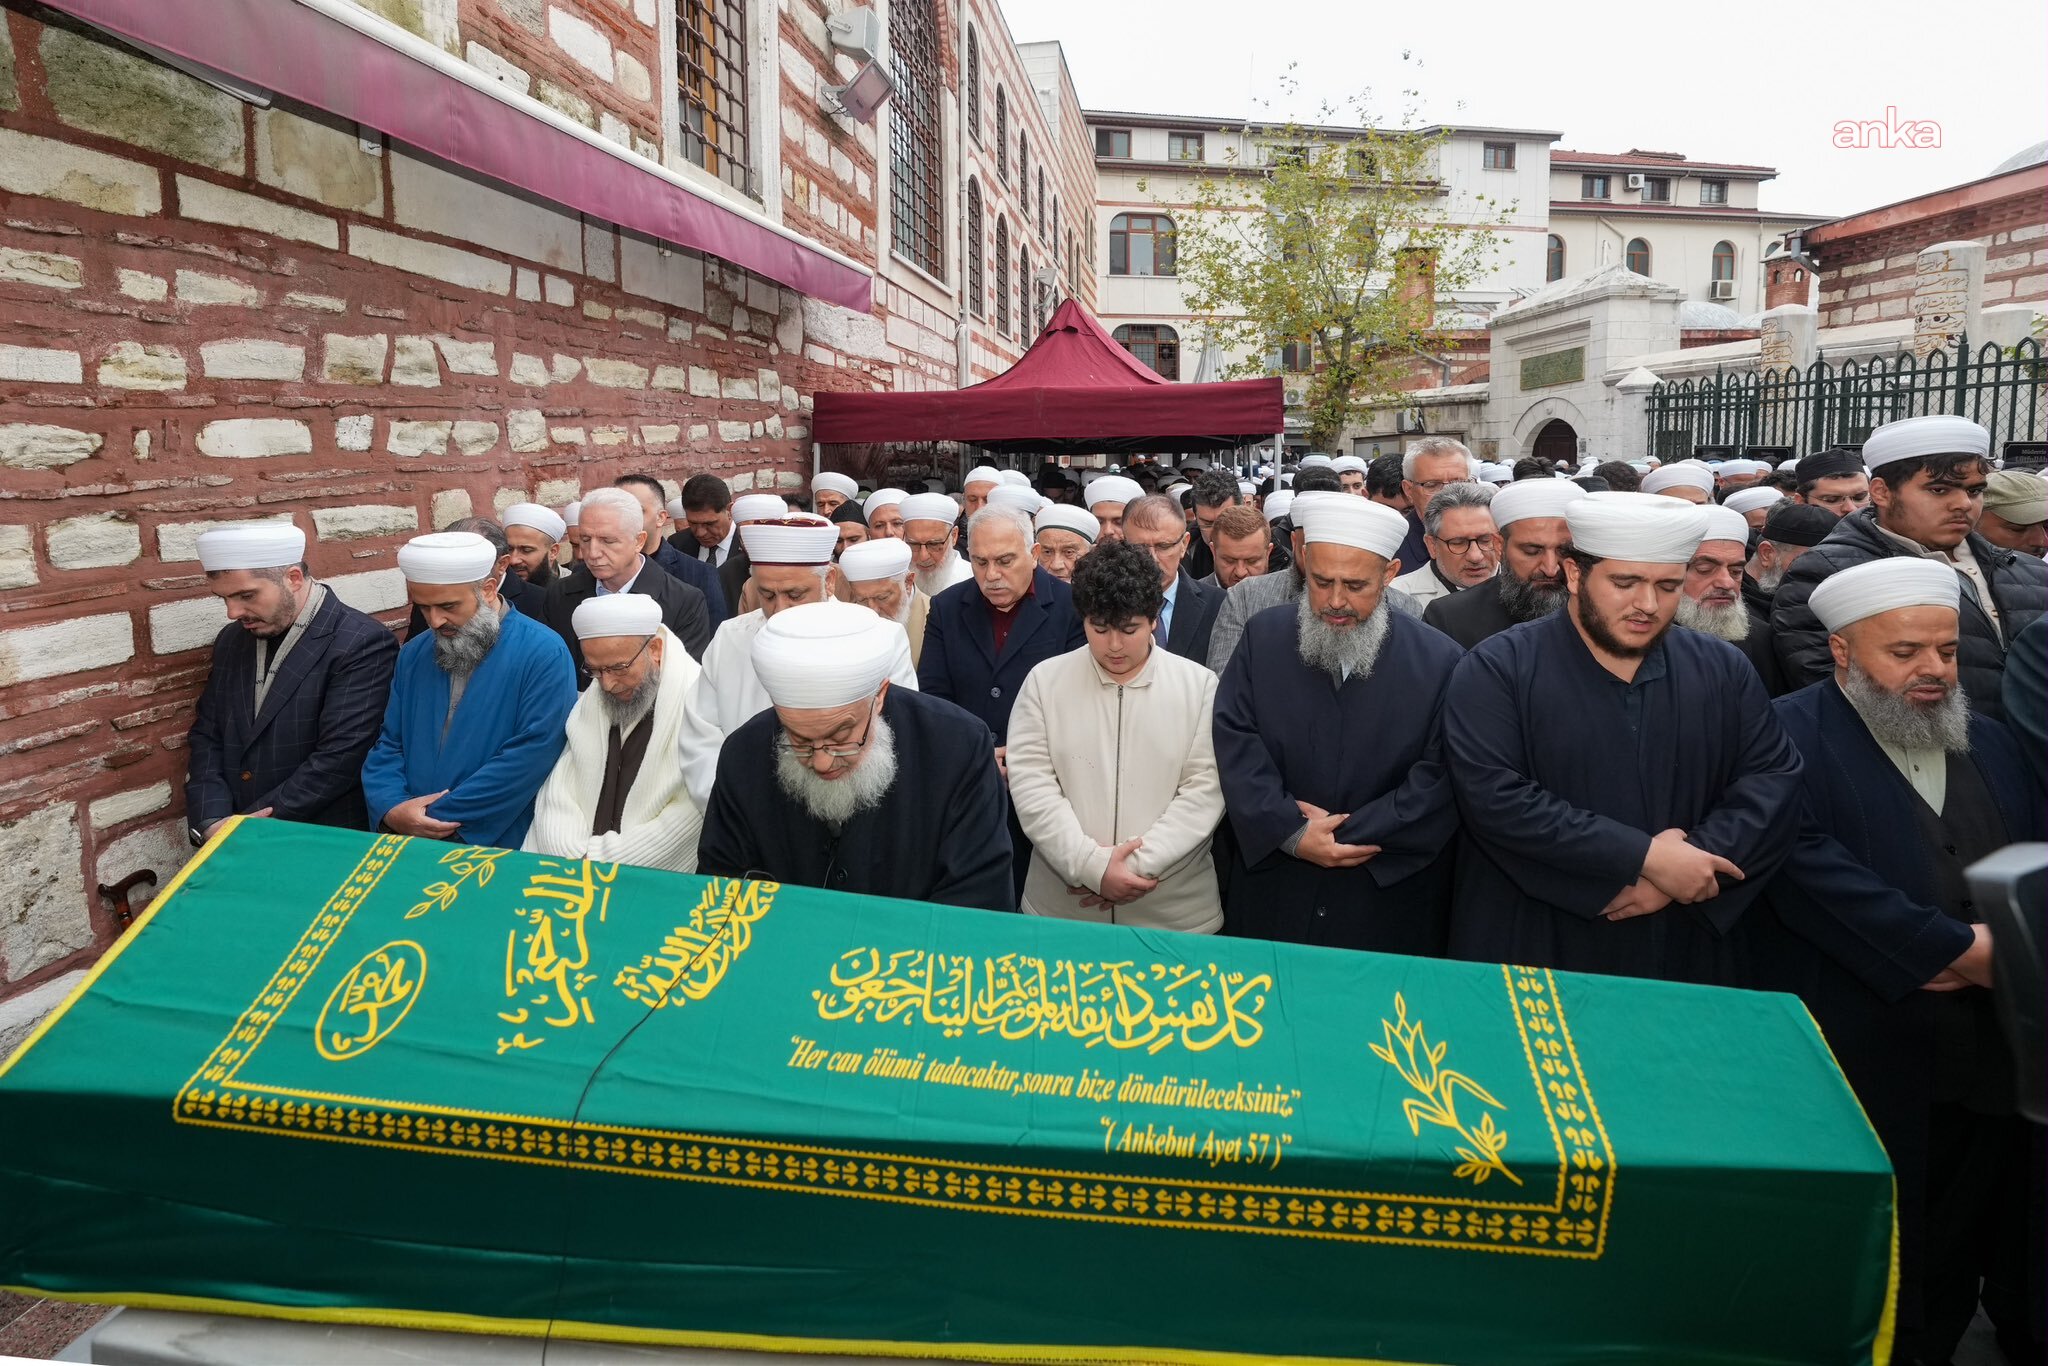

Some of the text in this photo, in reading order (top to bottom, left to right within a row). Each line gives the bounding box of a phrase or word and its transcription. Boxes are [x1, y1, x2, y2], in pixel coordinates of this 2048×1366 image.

[827, 1050, 863, 1074] can
[863, 1047, 926, 1080] ölümü
[1076, 1068, 1116, 1103] bize
[1115, 1122, 1197, 1158] Ankebut
[1199, 1129, 1243, 1168] Ayet
[1245, 1132, 1271, 1165] 57
